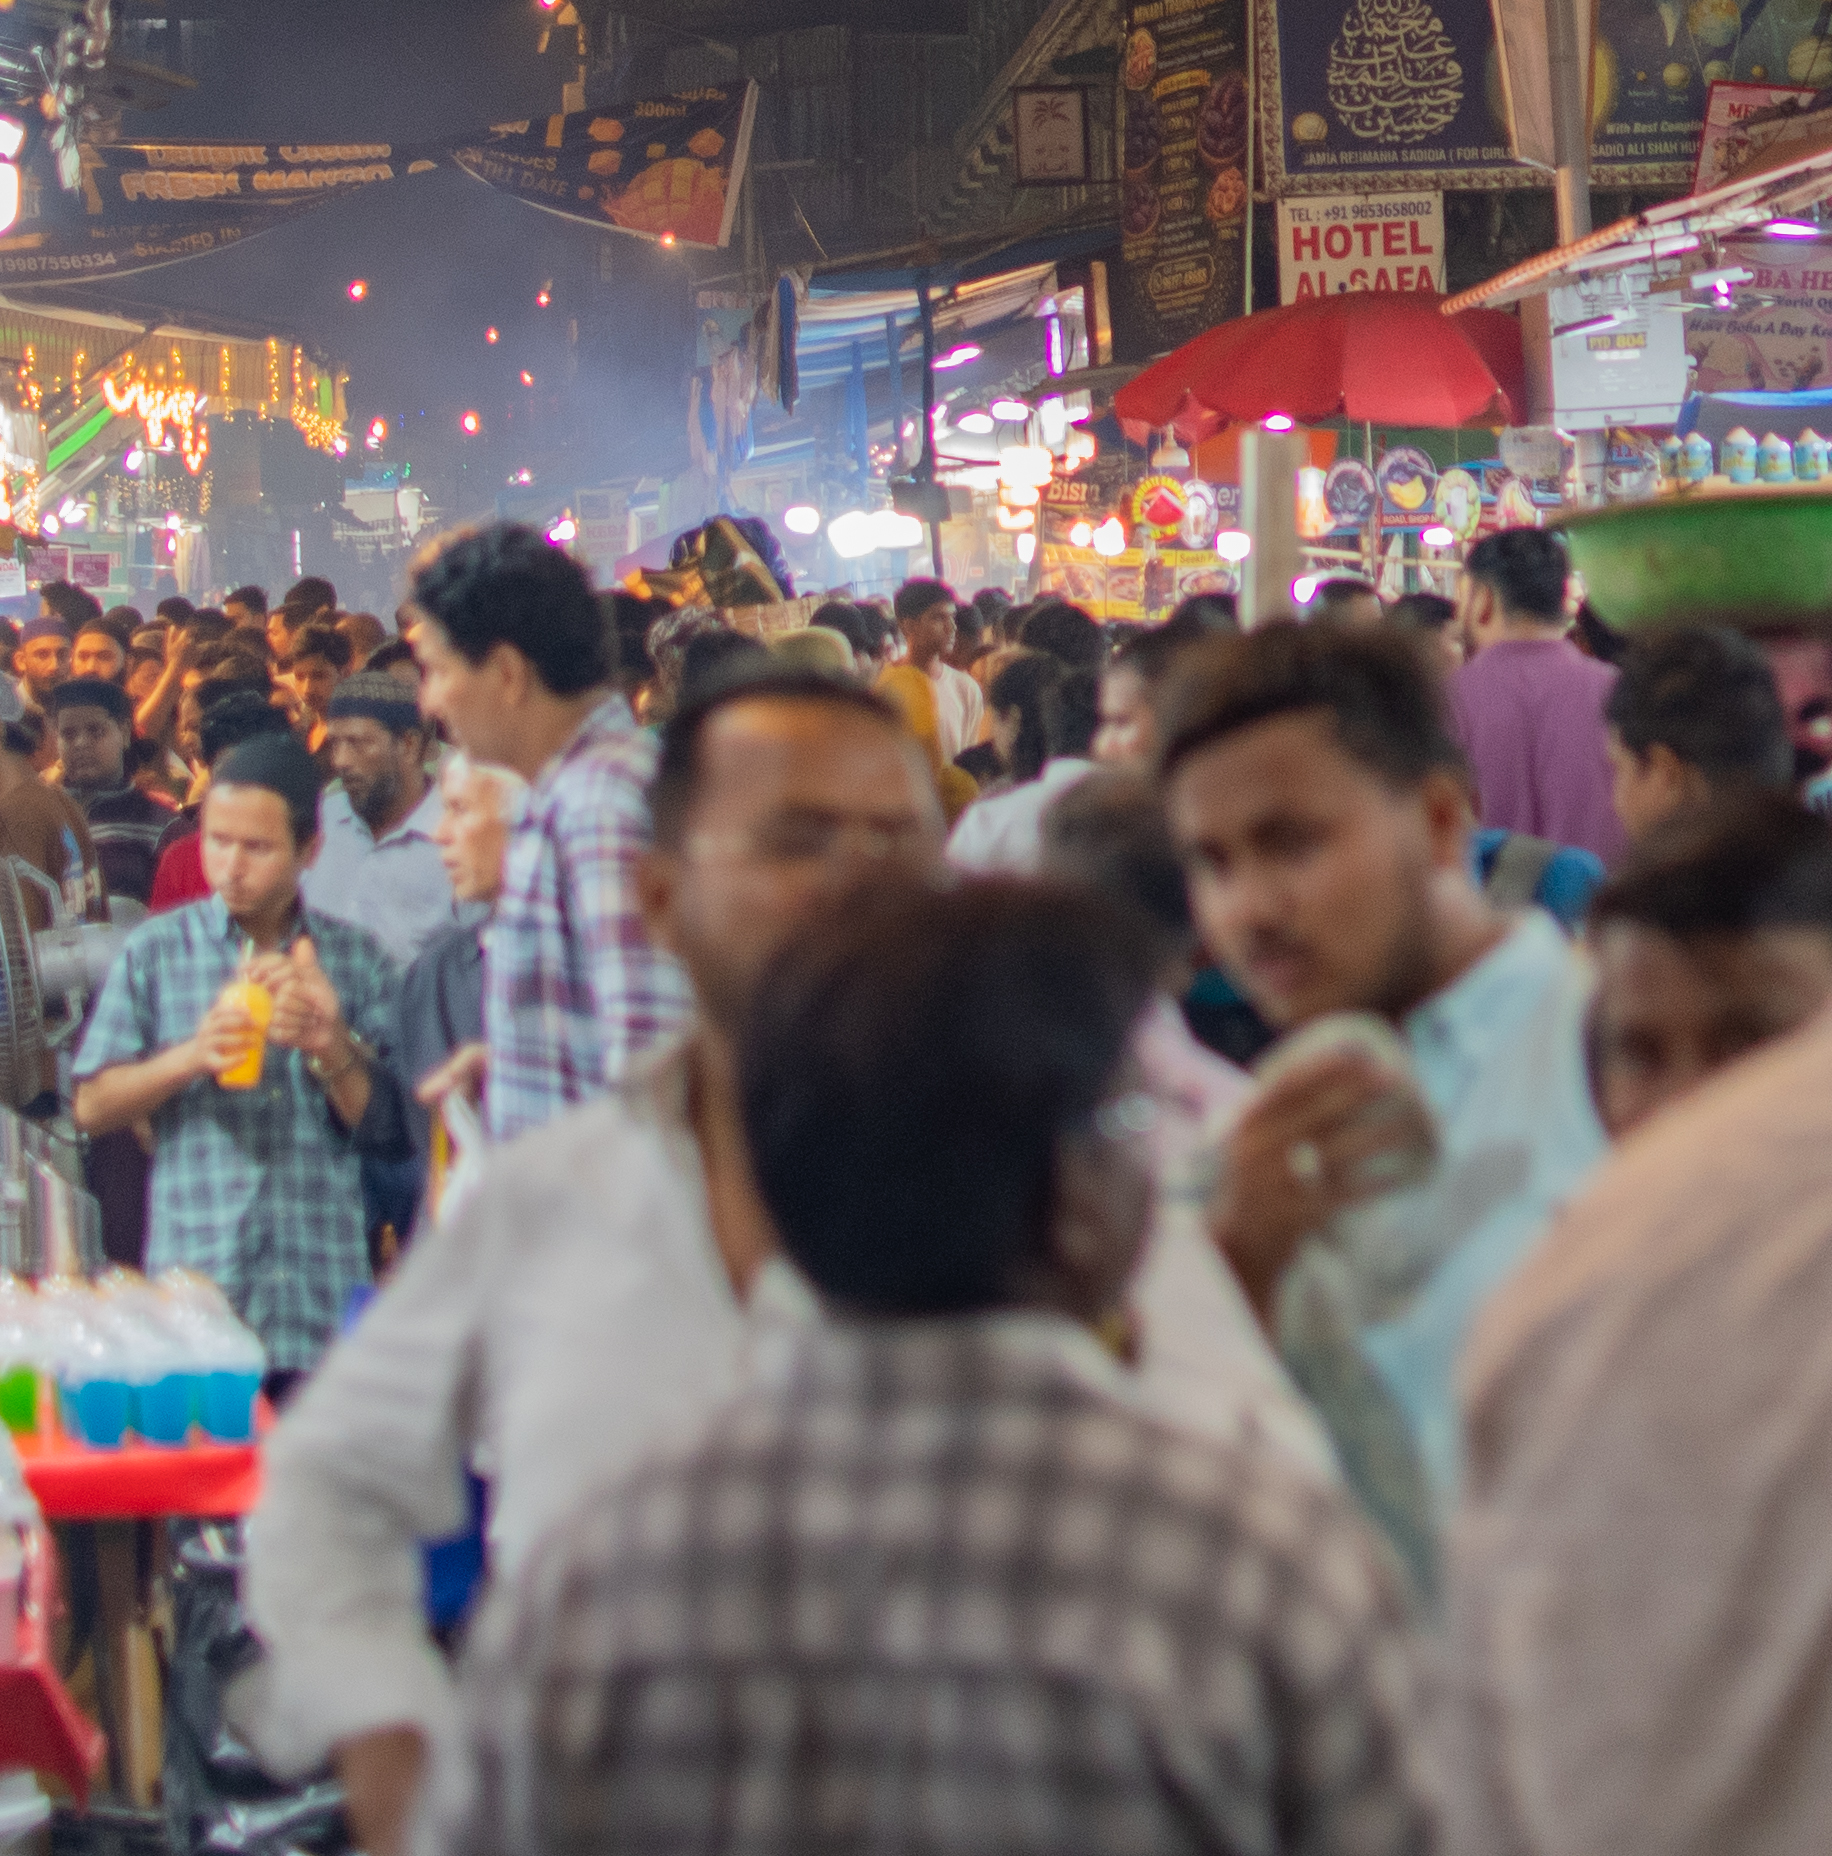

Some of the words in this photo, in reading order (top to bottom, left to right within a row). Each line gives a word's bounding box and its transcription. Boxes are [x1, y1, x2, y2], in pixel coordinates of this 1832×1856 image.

[1457, 148, 1479, 161] FOR
[1627, 143, 1645, 156] ALI
[1648, 142, 1678, 155] SHAH
[1289, 207, 1313, 222] TEL
[1324, 205, 1348, 221] +91
[1351, 200, 1432, 220] 9653658002
[1292, 220, 1434, 262] HOTEL
[1762, 321, 1776, 334] A
[1779, 321, 1807, 338] Day
